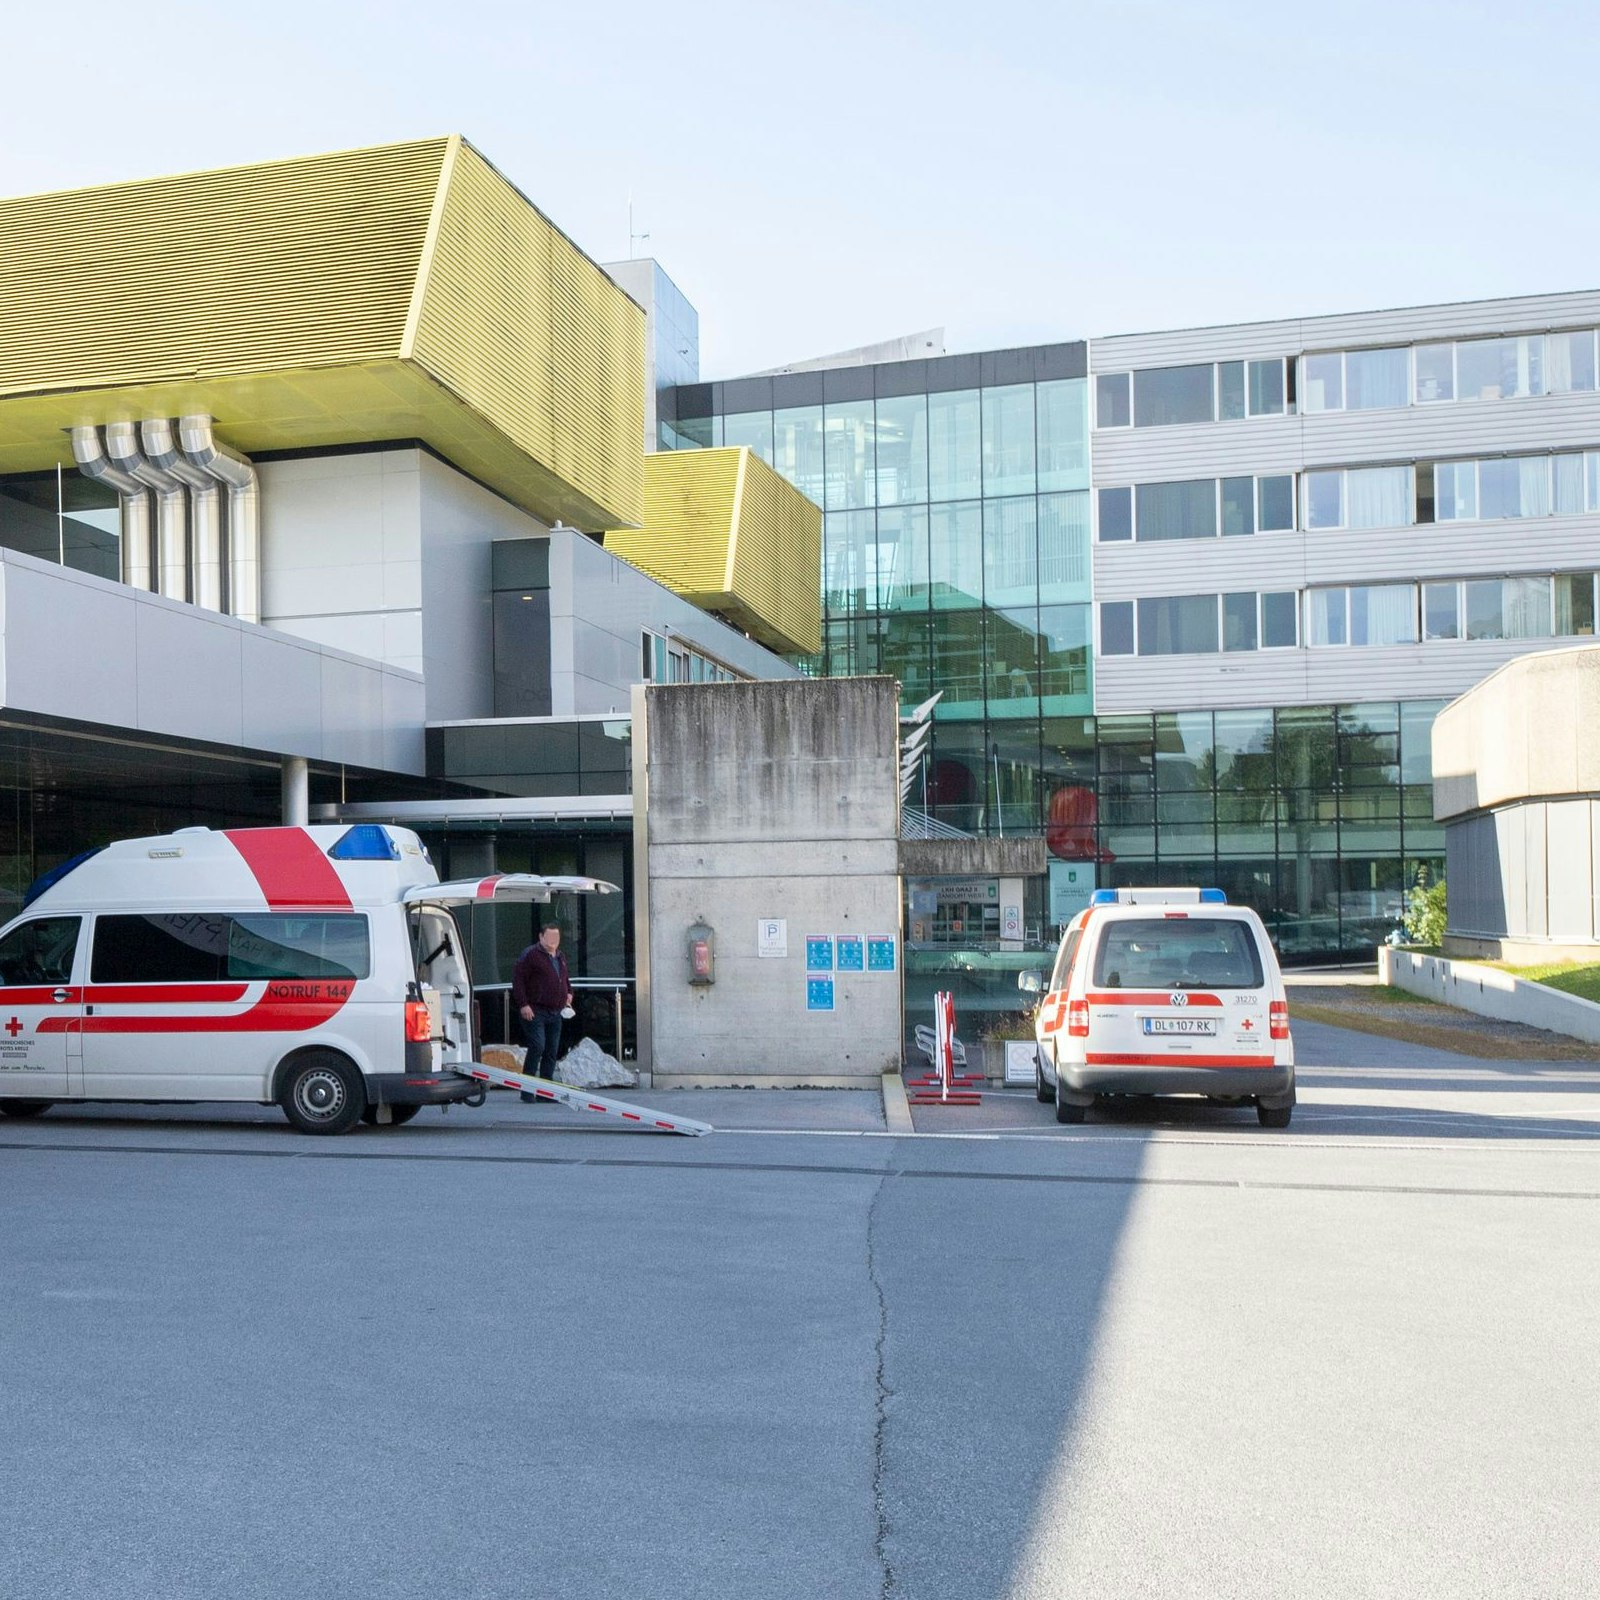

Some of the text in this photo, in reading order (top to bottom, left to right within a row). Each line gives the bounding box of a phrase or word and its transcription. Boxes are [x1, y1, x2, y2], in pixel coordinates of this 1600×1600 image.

[268, 984, 348, 998] NOTRUF 144
[1155, 1020, 1210, 1031] DL 107 RK
